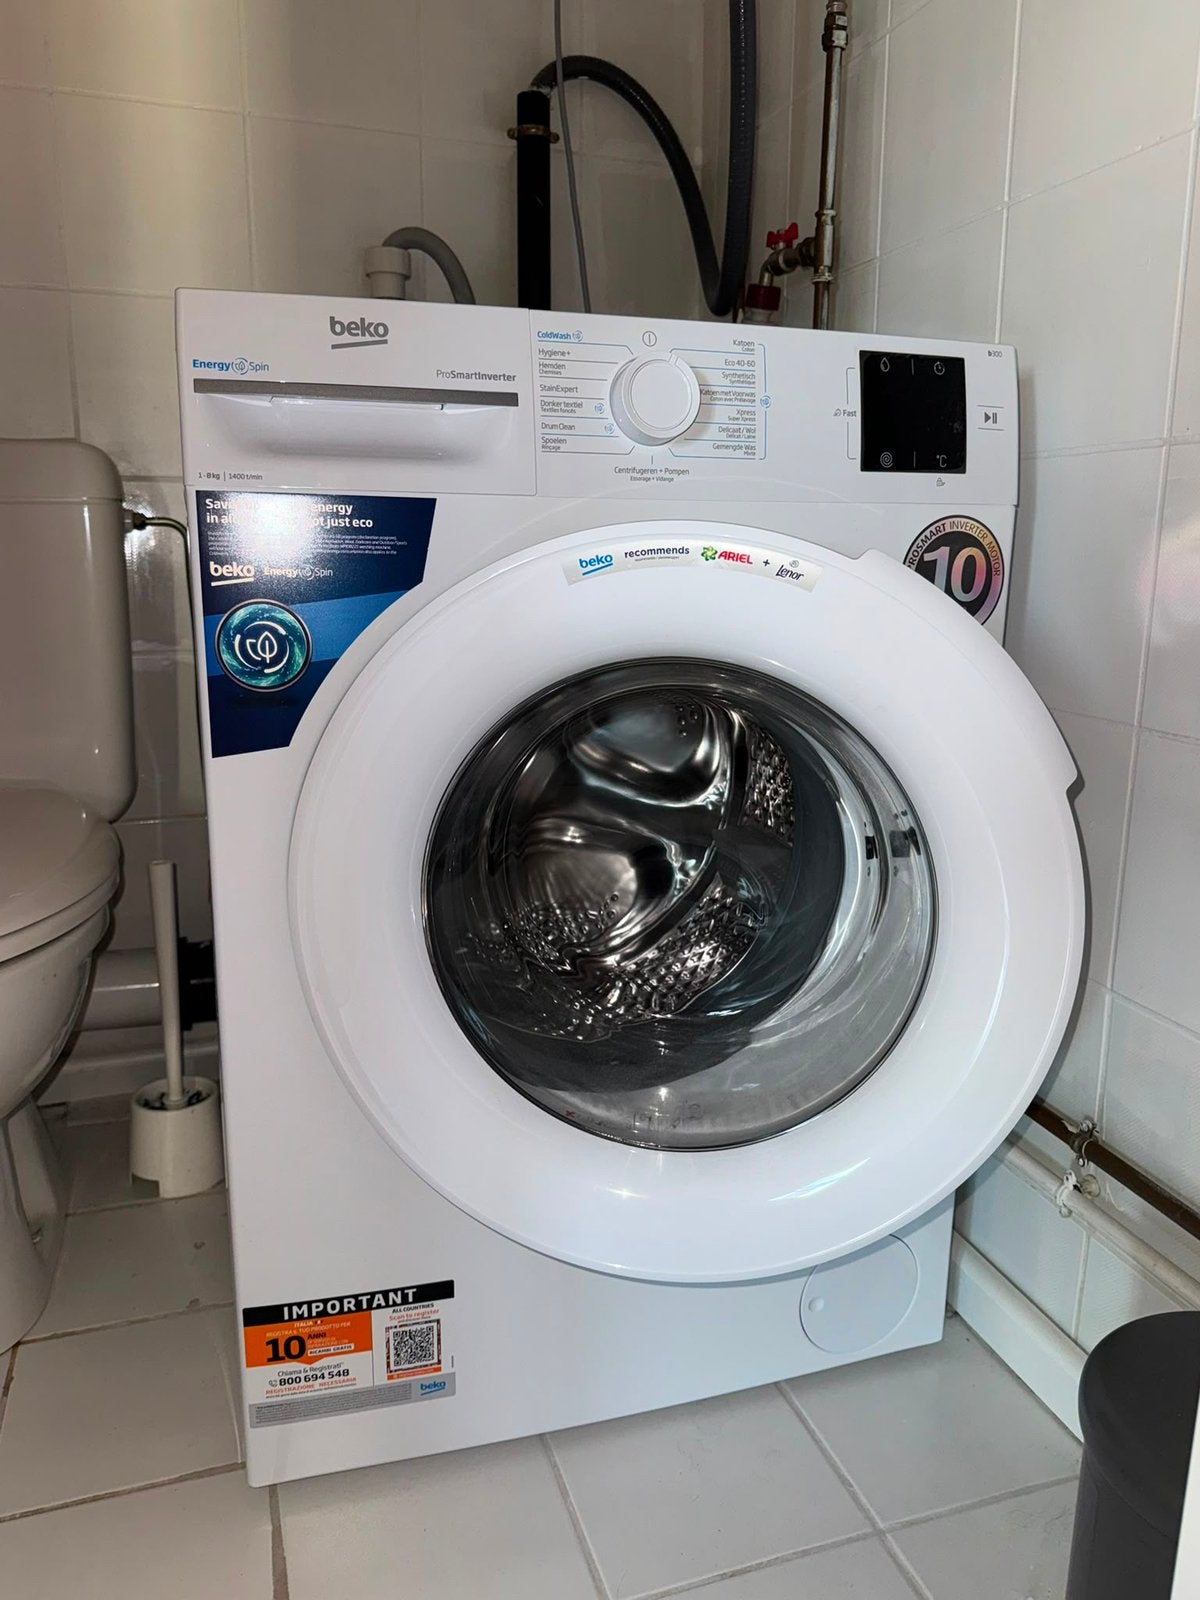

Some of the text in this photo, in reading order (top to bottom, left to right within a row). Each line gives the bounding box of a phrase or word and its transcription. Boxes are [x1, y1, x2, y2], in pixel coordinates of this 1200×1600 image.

[329, 316, 389, 338] beko
[537, 331, 571, 340] ColdWash
[192, 359, 270, 373] Energy Spin
[538, 362, 567, 370] Hemden
[724, 359, 756, 368] Eco 40-60
[436, 369, 517, 382] ProSmartInverter
[539, 384, 579, 394] StainExpert
[736, 409, 756, 417] Xpress
[541, 436, 567, 445] Spoelen
[712, 443, 744, 451] Gemengde
[613, 466, 658, 475] Centrifugeren
[664, 468, 690, 476] Pompen
[205, 499, 353, 516] Sav energy
[206, 513, 219, 523] in
[326, 516, 350, 528] just
[352, 519, 373, 528] eco
[949, 521, 989, 542] INVERTER
[985, 541, 1001, 577] MOTOR
[579, 554, 614, 568] beko
[624, 546, 690, 558] recommends
[717, 550, 753, 565] ARIEL
[775, 564, 805, 580] Lenor
[209, 561, 334, 578] beko Energy Spin
[923, 546, 987, 602] 10
[283, 1288, 417, 1321] IMPORTANT
[403, 1303, 435, 1312] COUNTRIES
[389, 1313, 405, 1321] Scan
[413, 1308, 440, 1319] register
[294, 1320, 314, 1328] ITALIA
[307, 1331, 327, 1340] ANNI
[265, 1335, 307, 1362] 10
[277, 1368, 302, 1378] Chiama
[279, 1368, 350, 1386] 800 694 548
[420, 1381, 446, 1391] beko
